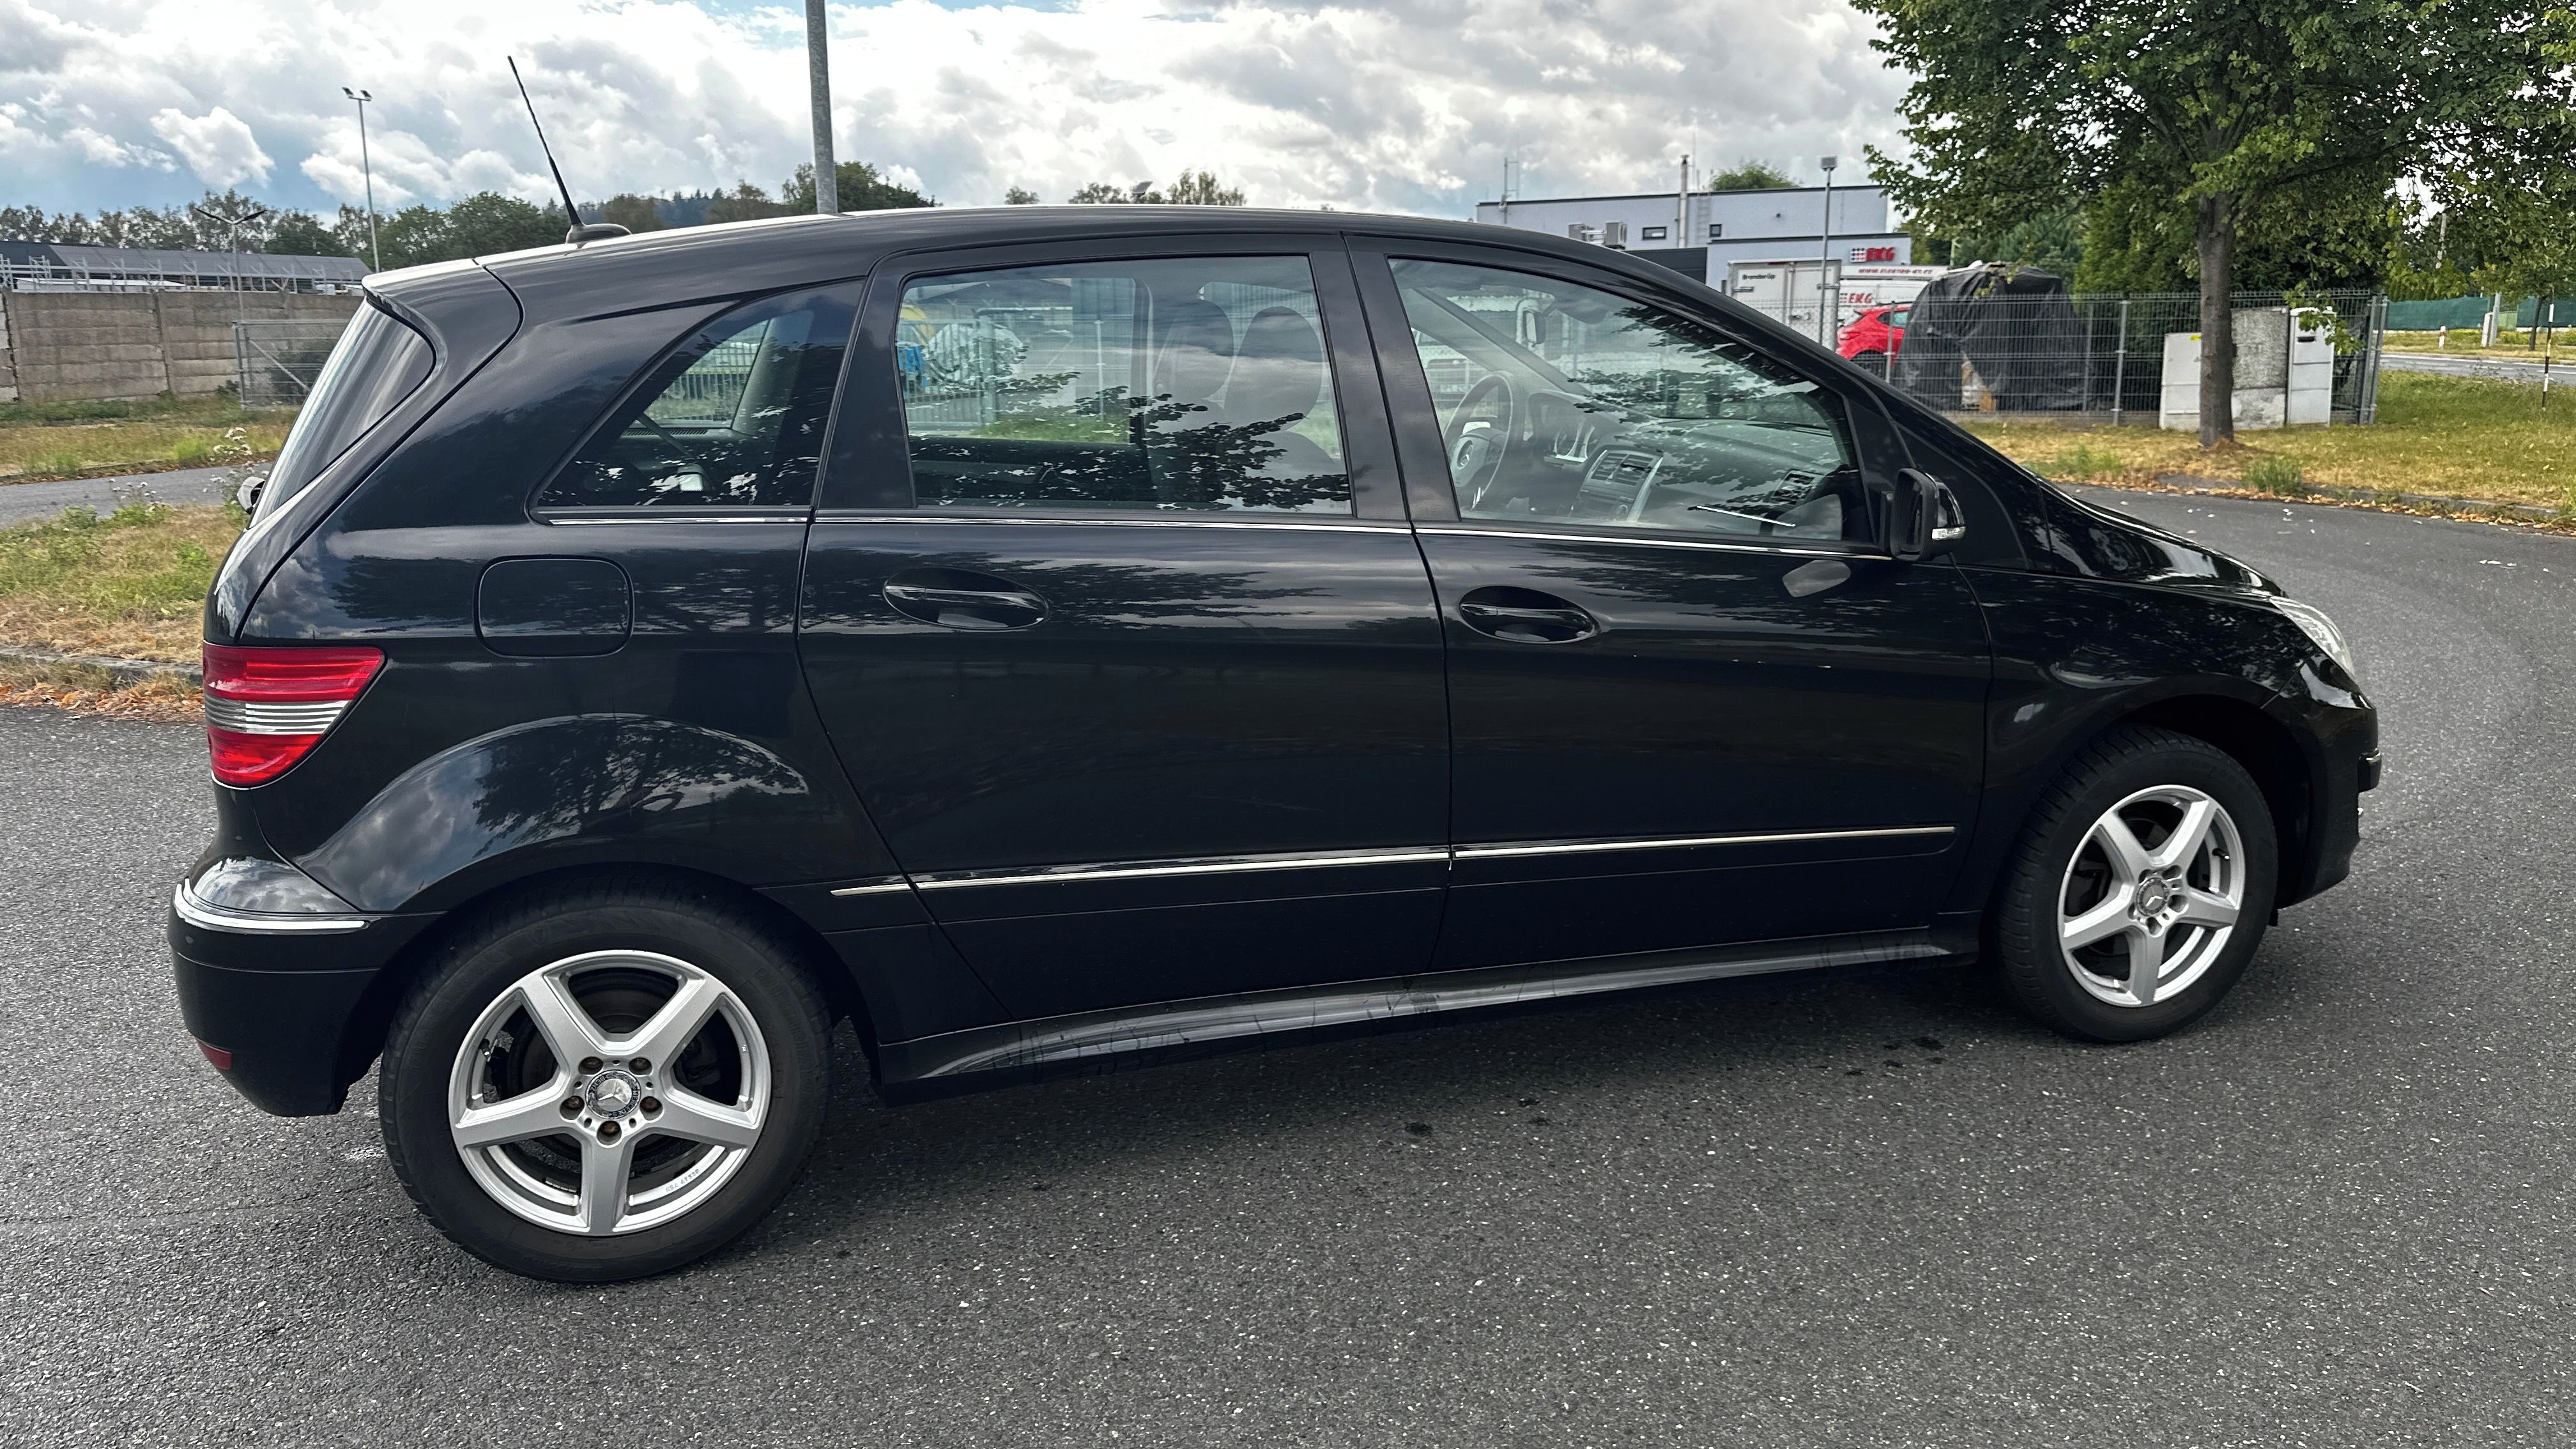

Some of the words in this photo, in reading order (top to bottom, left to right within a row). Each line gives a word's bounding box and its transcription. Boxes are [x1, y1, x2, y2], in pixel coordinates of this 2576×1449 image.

[1866, 247, 1896, 262] EKG
[1848, 293, 1872, 303] EKG
[589, 1075, 606, 1092] BENZ
[613, 1090, 639, 1117] MERCEDES
